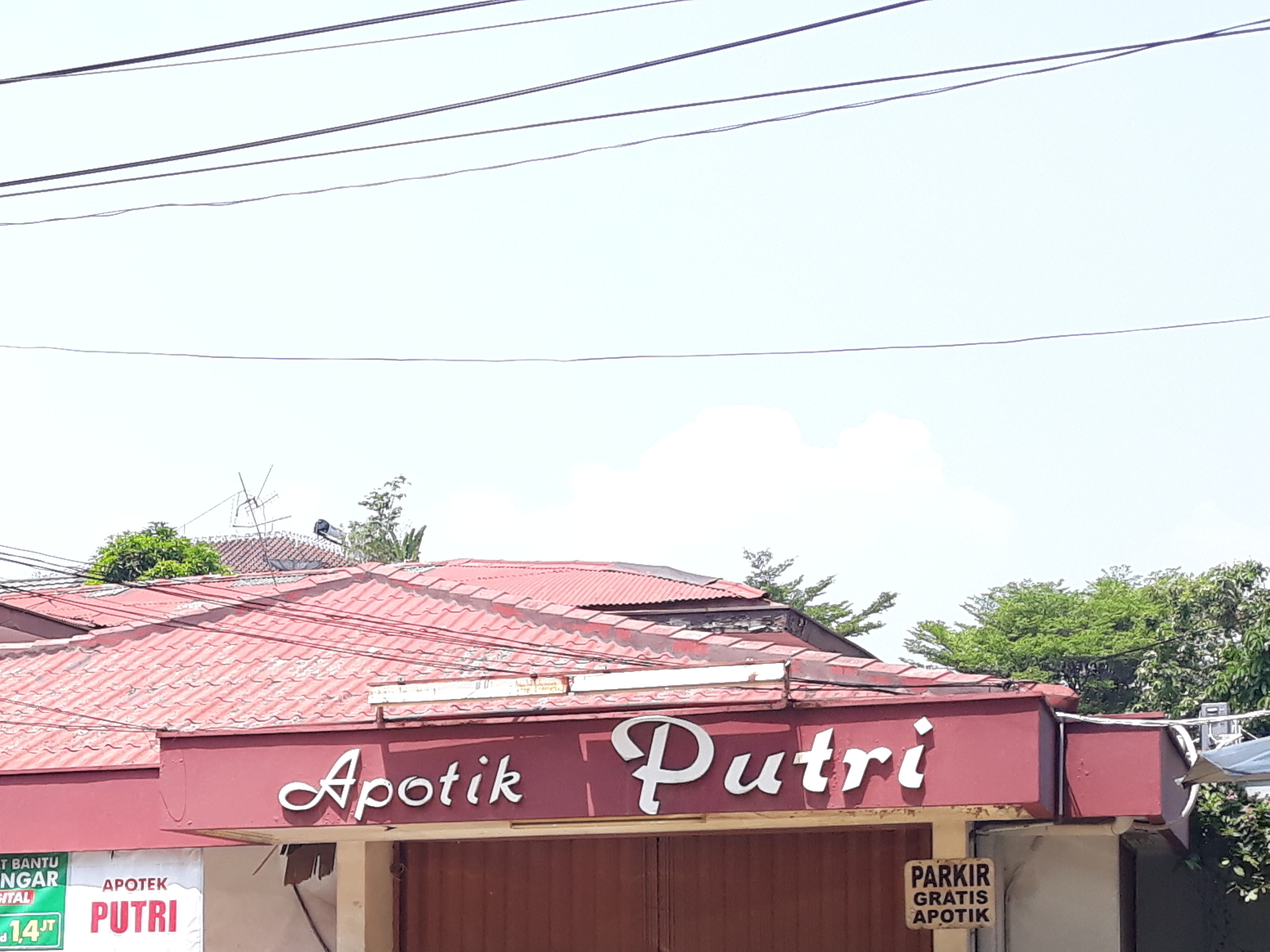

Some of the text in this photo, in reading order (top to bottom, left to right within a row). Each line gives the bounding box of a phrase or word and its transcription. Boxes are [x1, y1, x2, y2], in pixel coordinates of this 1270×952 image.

[278, 715, 933, 820] Apotik Putri
[11, 857, 58, 870] BANTU
[911, 863, 990, 888] PARKIR
[102, 877, 168, 892] APOTEK
[913, 890, 988, 906] GRATIS
[90, 900, 177, 934] PUTRI
[913, 908, 990, 924] APOTIK
